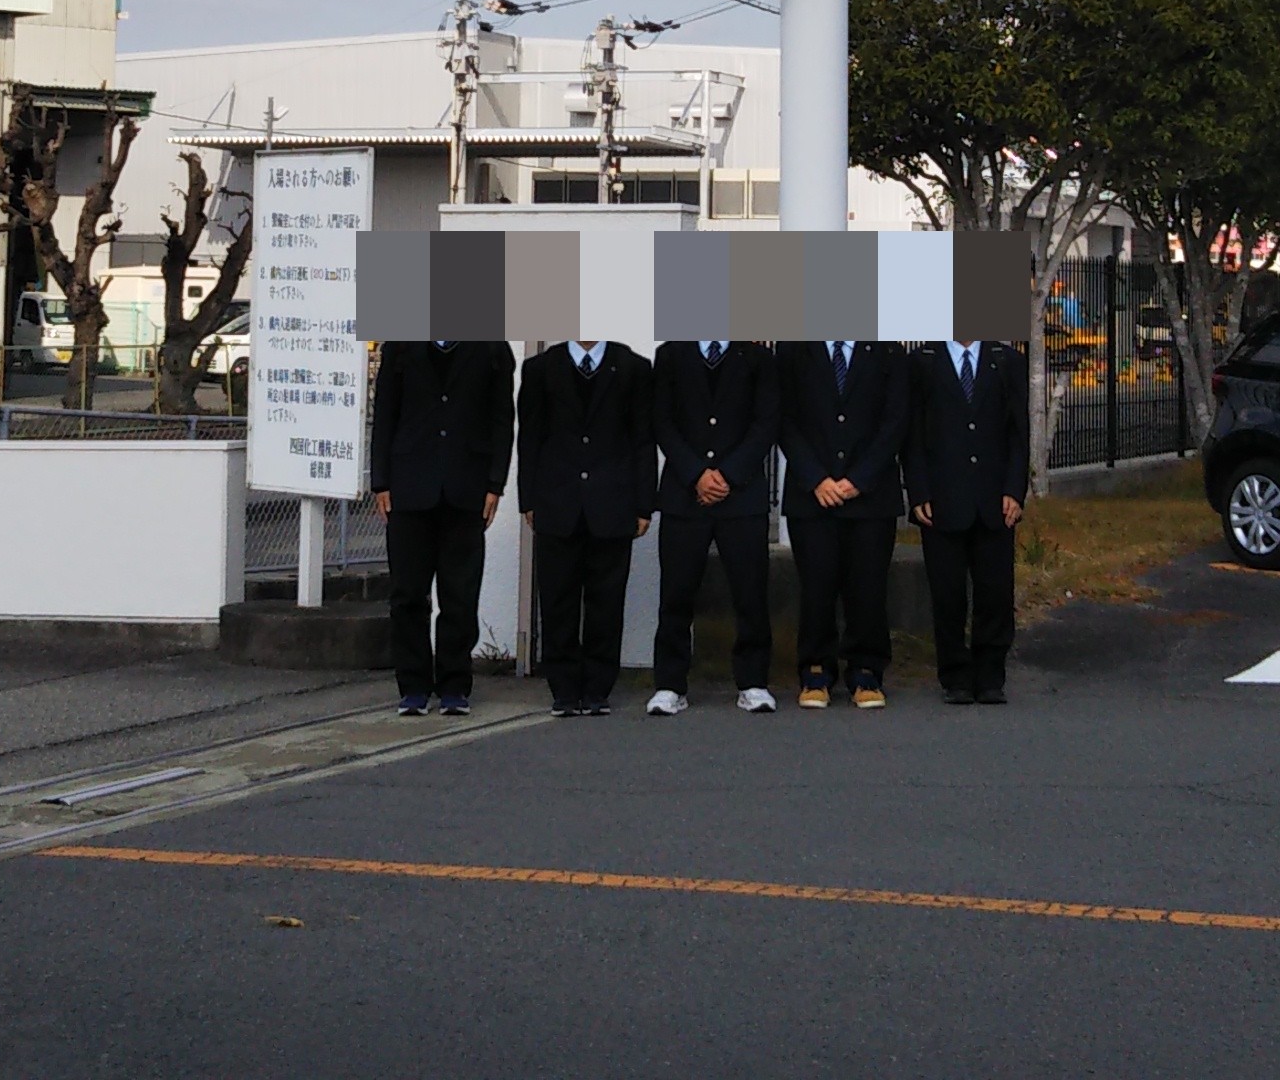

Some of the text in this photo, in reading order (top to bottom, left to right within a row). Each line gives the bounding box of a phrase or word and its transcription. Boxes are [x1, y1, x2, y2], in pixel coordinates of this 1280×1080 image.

[268, 166, 360, 188] 入場される方へのお願い
[289, 437, 354, 460] 四国化工機株式会社
